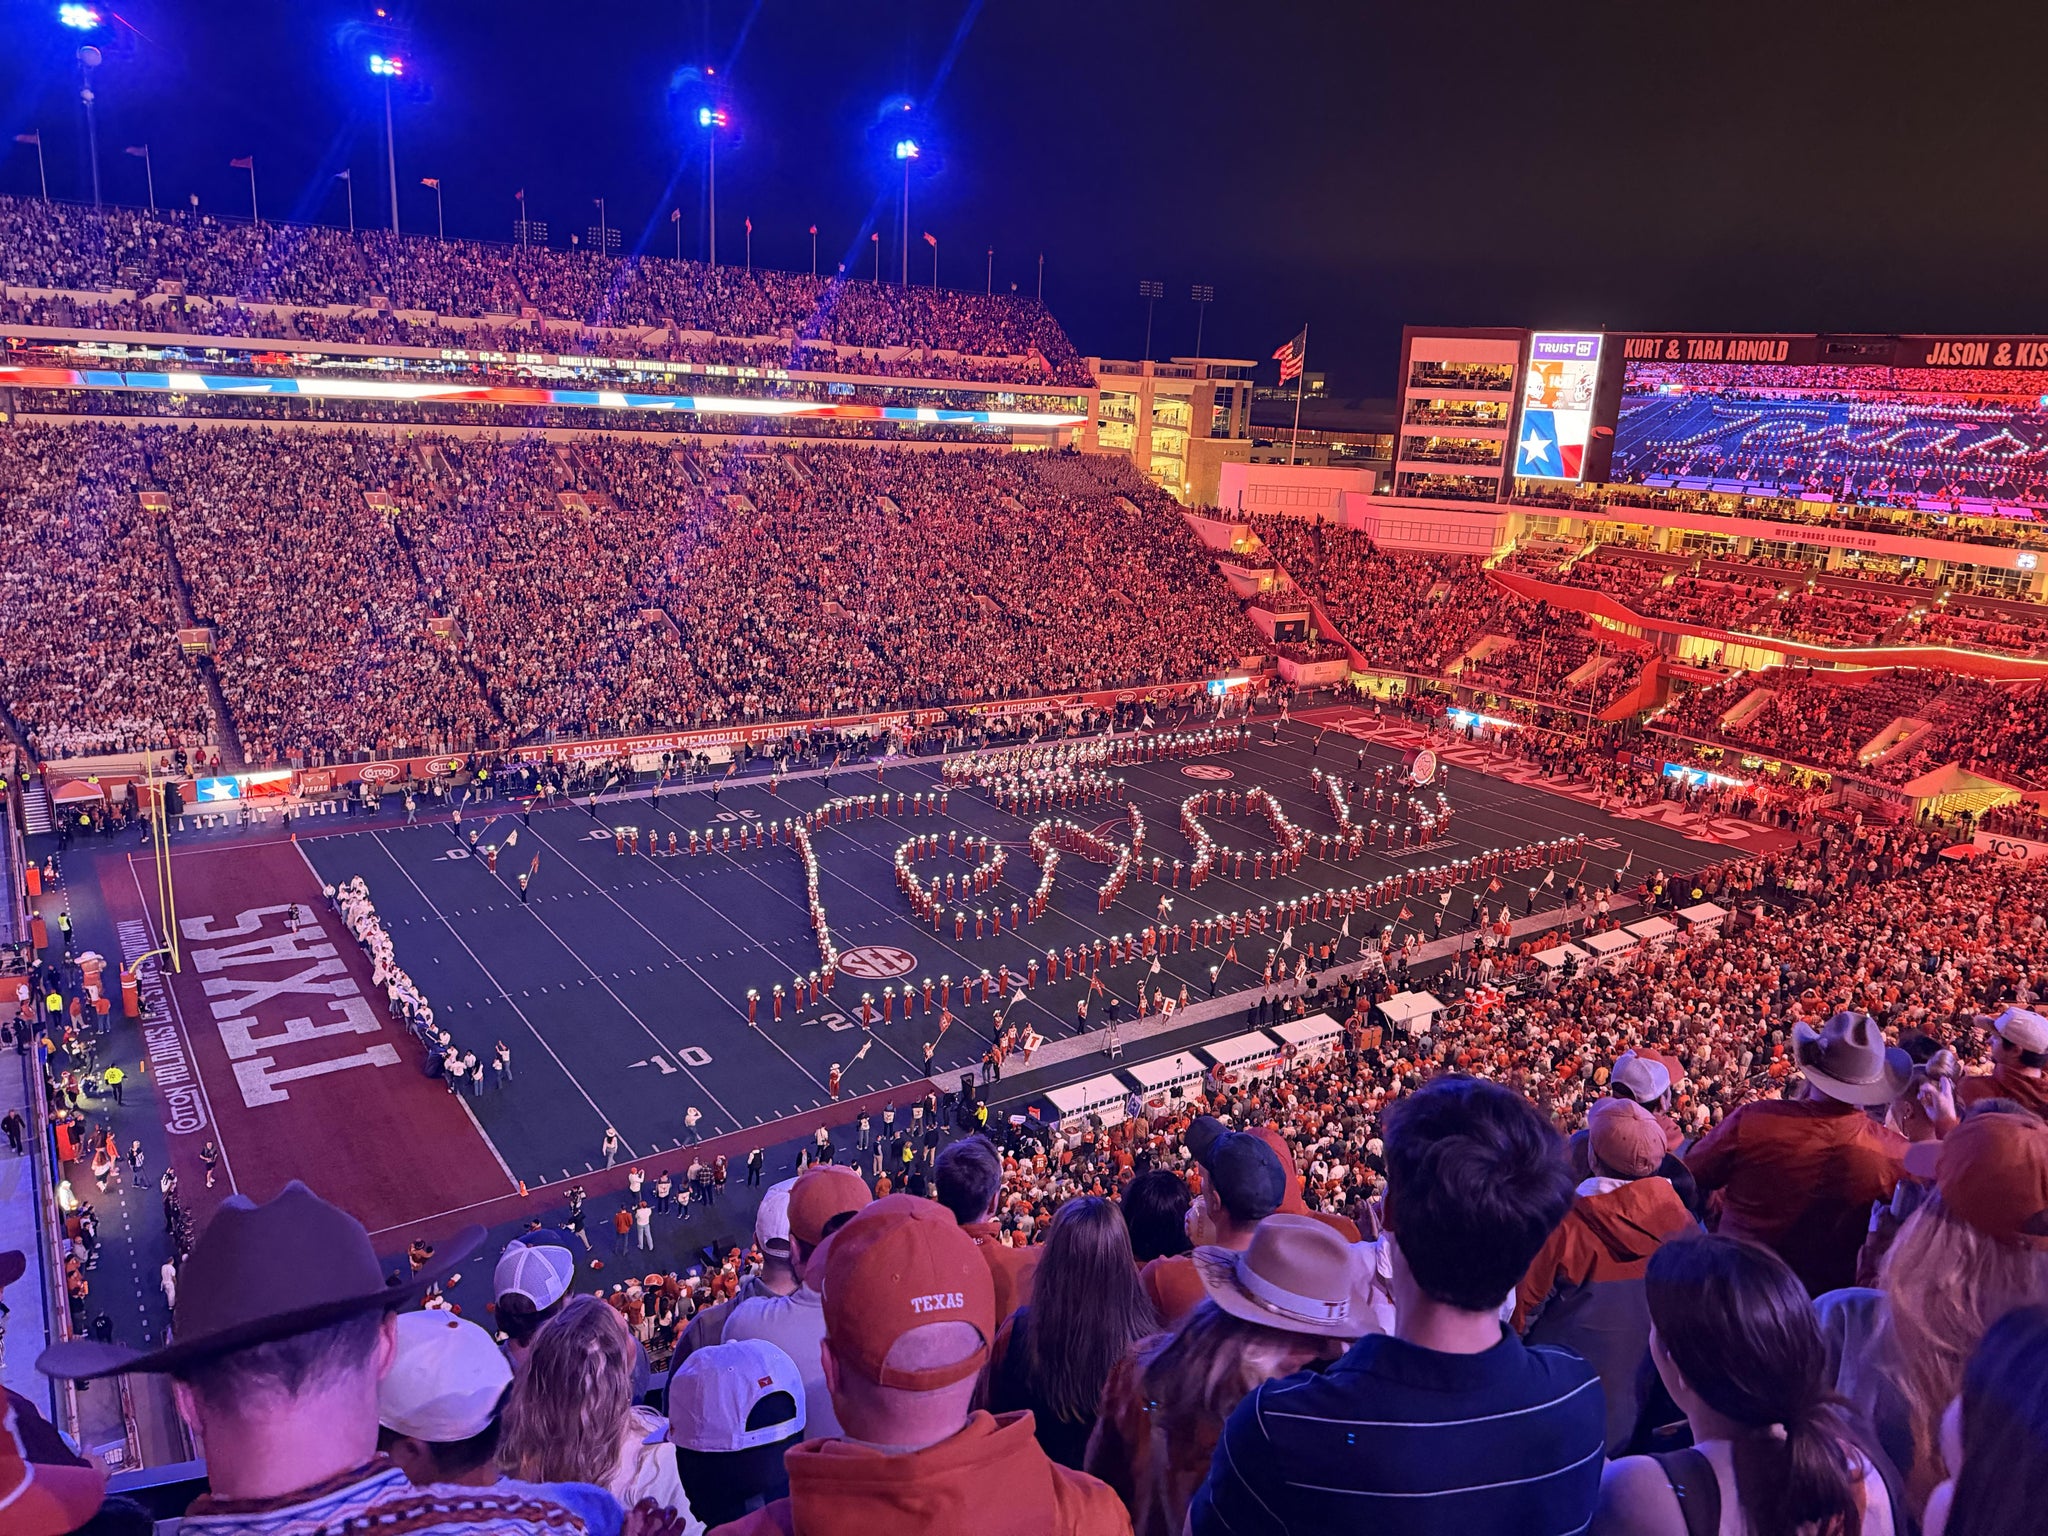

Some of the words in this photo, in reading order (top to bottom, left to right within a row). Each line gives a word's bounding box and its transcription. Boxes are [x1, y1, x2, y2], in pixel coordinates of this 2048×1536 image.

[1538, 342, 1576, 354] TRUIST
[1624, 339, 1663, 359] KURT
[1664, 340, 1681, 360] &
[1687, 340, 1723, 360] TARA
[1725, 341, 1790, 362] ARNOLD
[1926, 342, 1990, 367] JASON
[1992, 343, 2012, 367] &
[556, 747, 569, 761] K
[676, 729, 748, 749] MEMORIAL
[1633, 755, 1652, 767] DELL
[364, 767, 395, 779] COTTON
[304, 784, 329, 794] TEXAS
[1857, 781, 1884, 798] BEVO
[842, 945, 910, 975] SEC
[180, 903, 401, 1108] TEXAS
[1165, 1000, 1175, 1014] E
[1029, 1035, 1040, 1048] T
[143, 1023, 191, 1087] HOLDINGS
[649, 1045, 714, 1076] 10
[164, 1084, 208, 1135] COTTON
[910, 1292, 964, 1314] TEXAS
